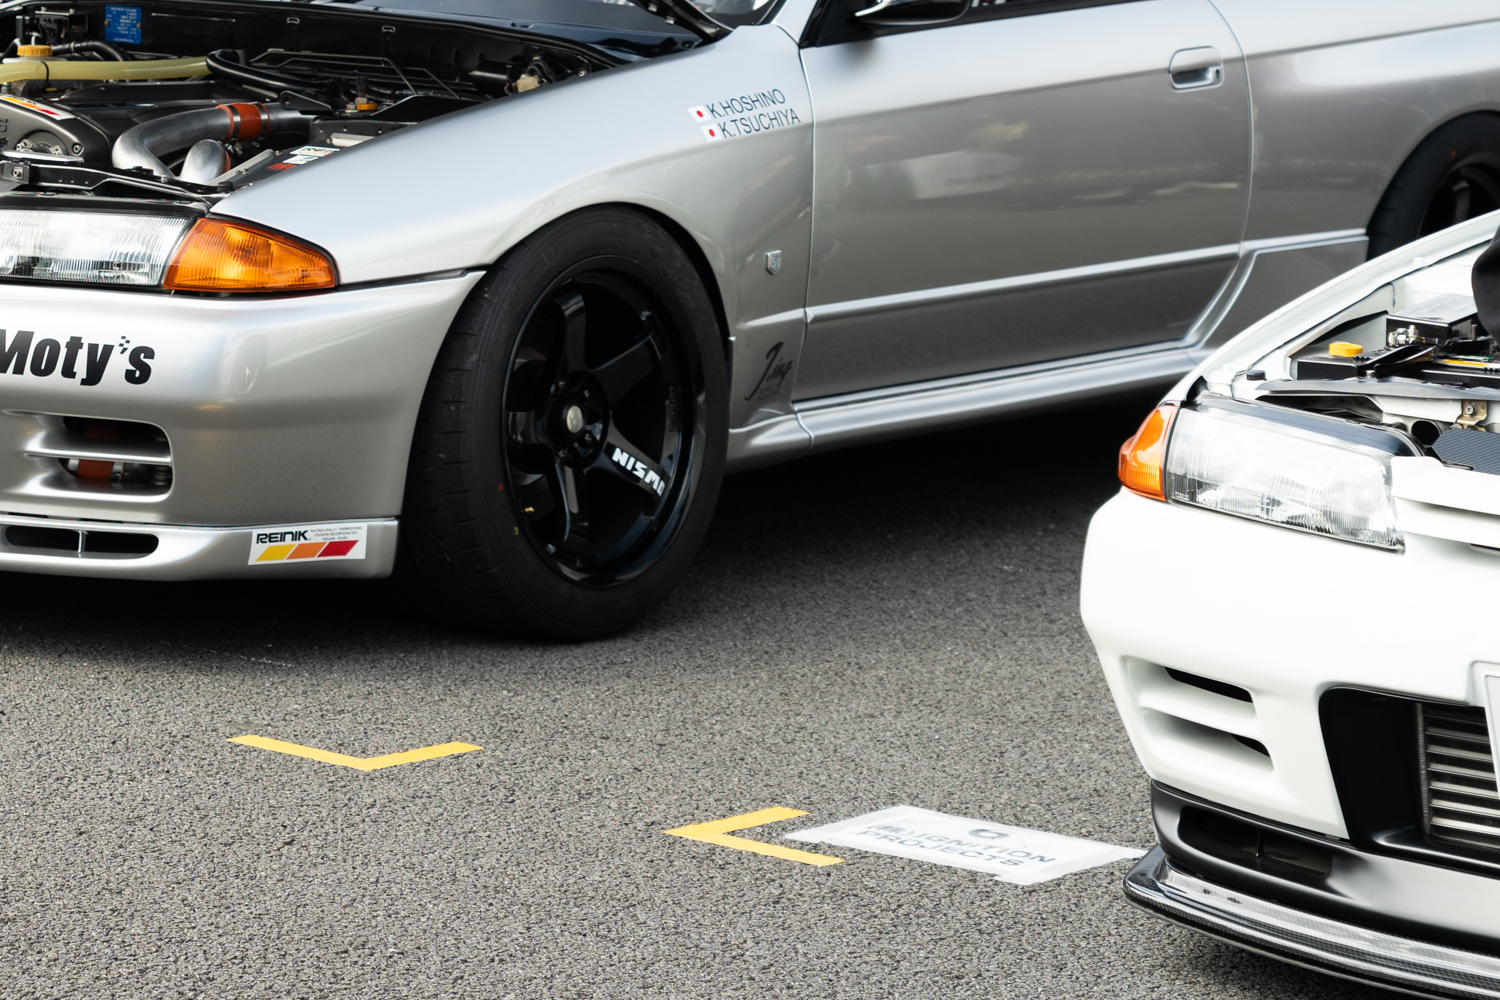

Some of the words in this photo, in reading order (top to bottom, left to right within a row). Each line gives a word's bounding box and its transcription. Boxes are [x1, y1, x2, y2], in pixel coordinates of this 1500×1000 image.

[706, 88, 786, 119] K.HOSHINO
[717, 107, 801, 139] K.TSUCHIYA
[255, 529, 310, 545] REINIK
[856, 830, 1025, 867] PROJECTS
